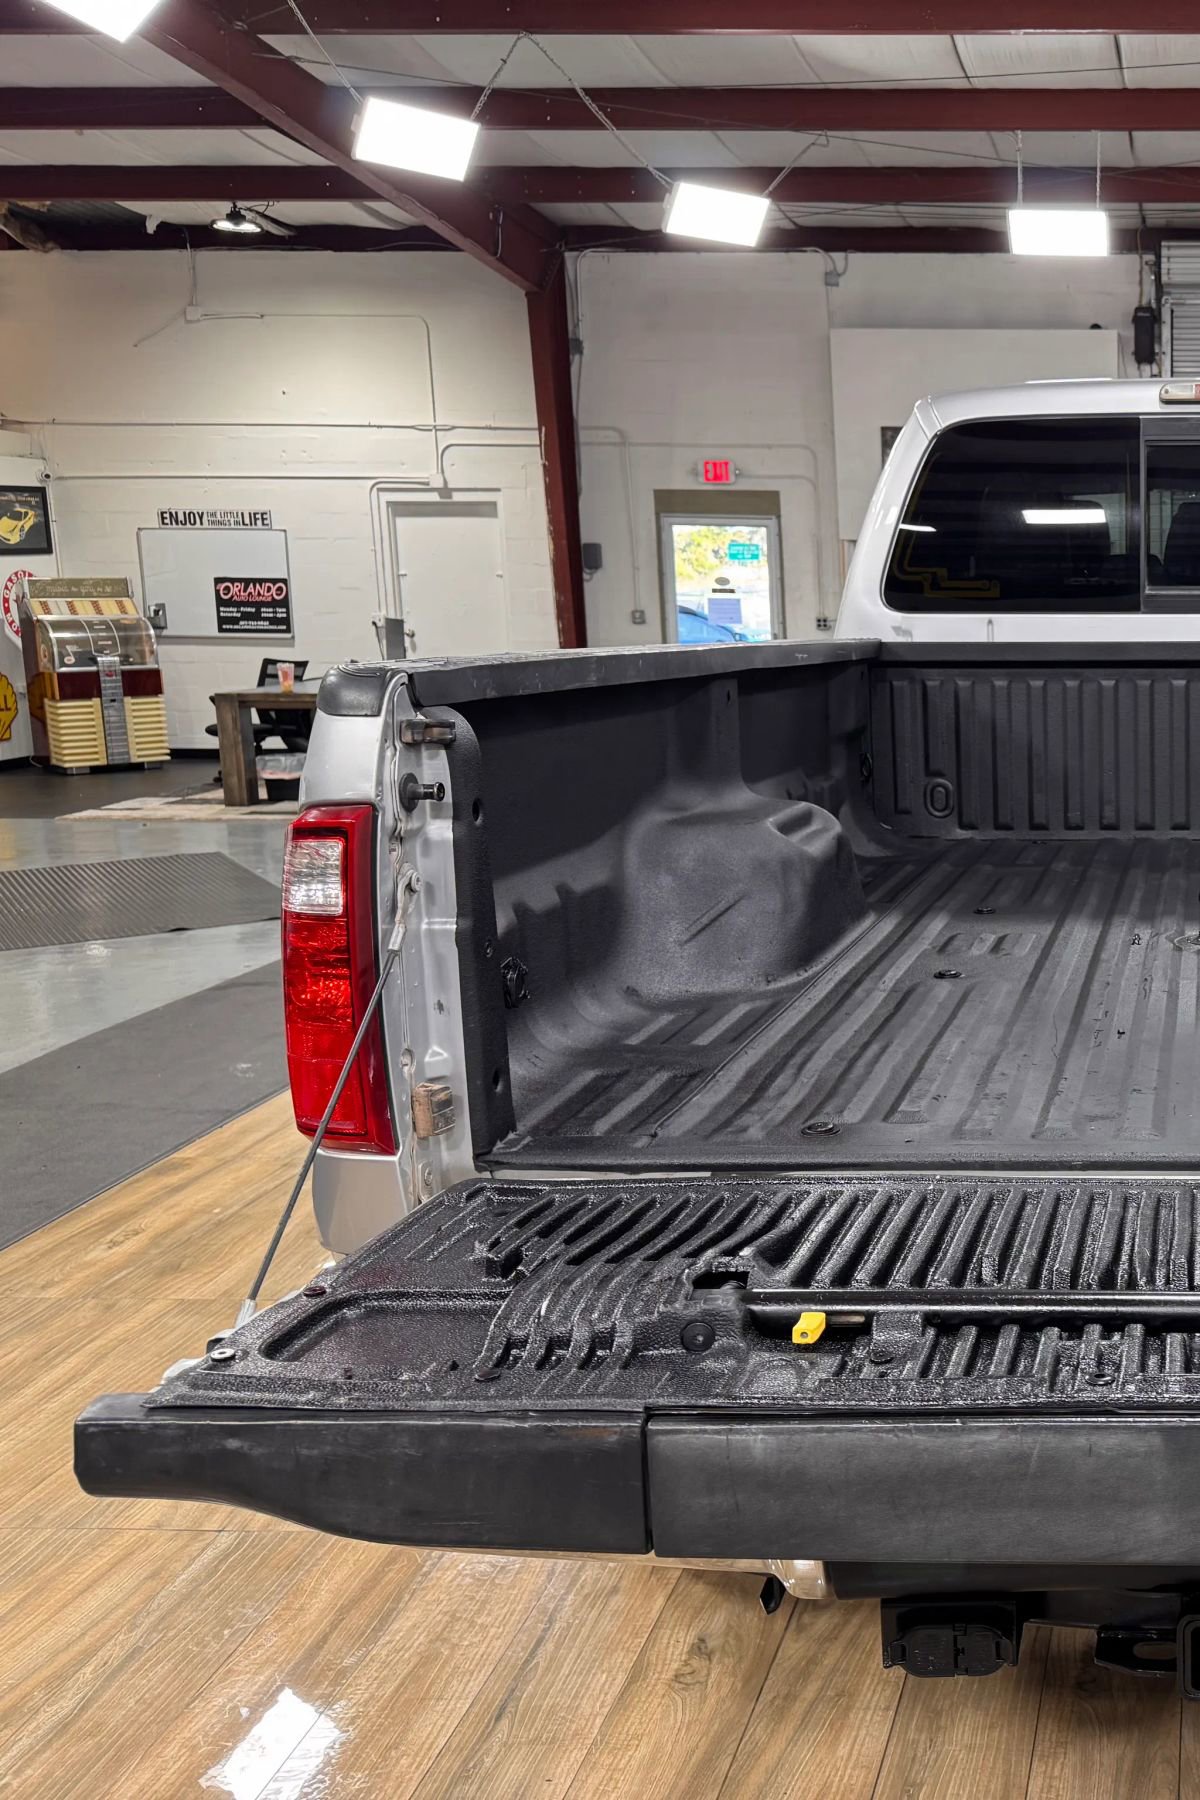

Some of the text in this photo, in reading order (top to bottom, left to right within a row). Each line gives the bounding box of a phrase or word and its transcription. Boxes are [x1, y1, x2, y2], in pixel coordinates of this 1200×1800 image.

[703, 460, 729, 482] EXIT
[160, 511, 204, 526] ENJOY
[206, 511, 240, 519] THE LITTLE
[241, 512, 269, 526] LIFE
[220, 582, 286, 600] ORLANDO
